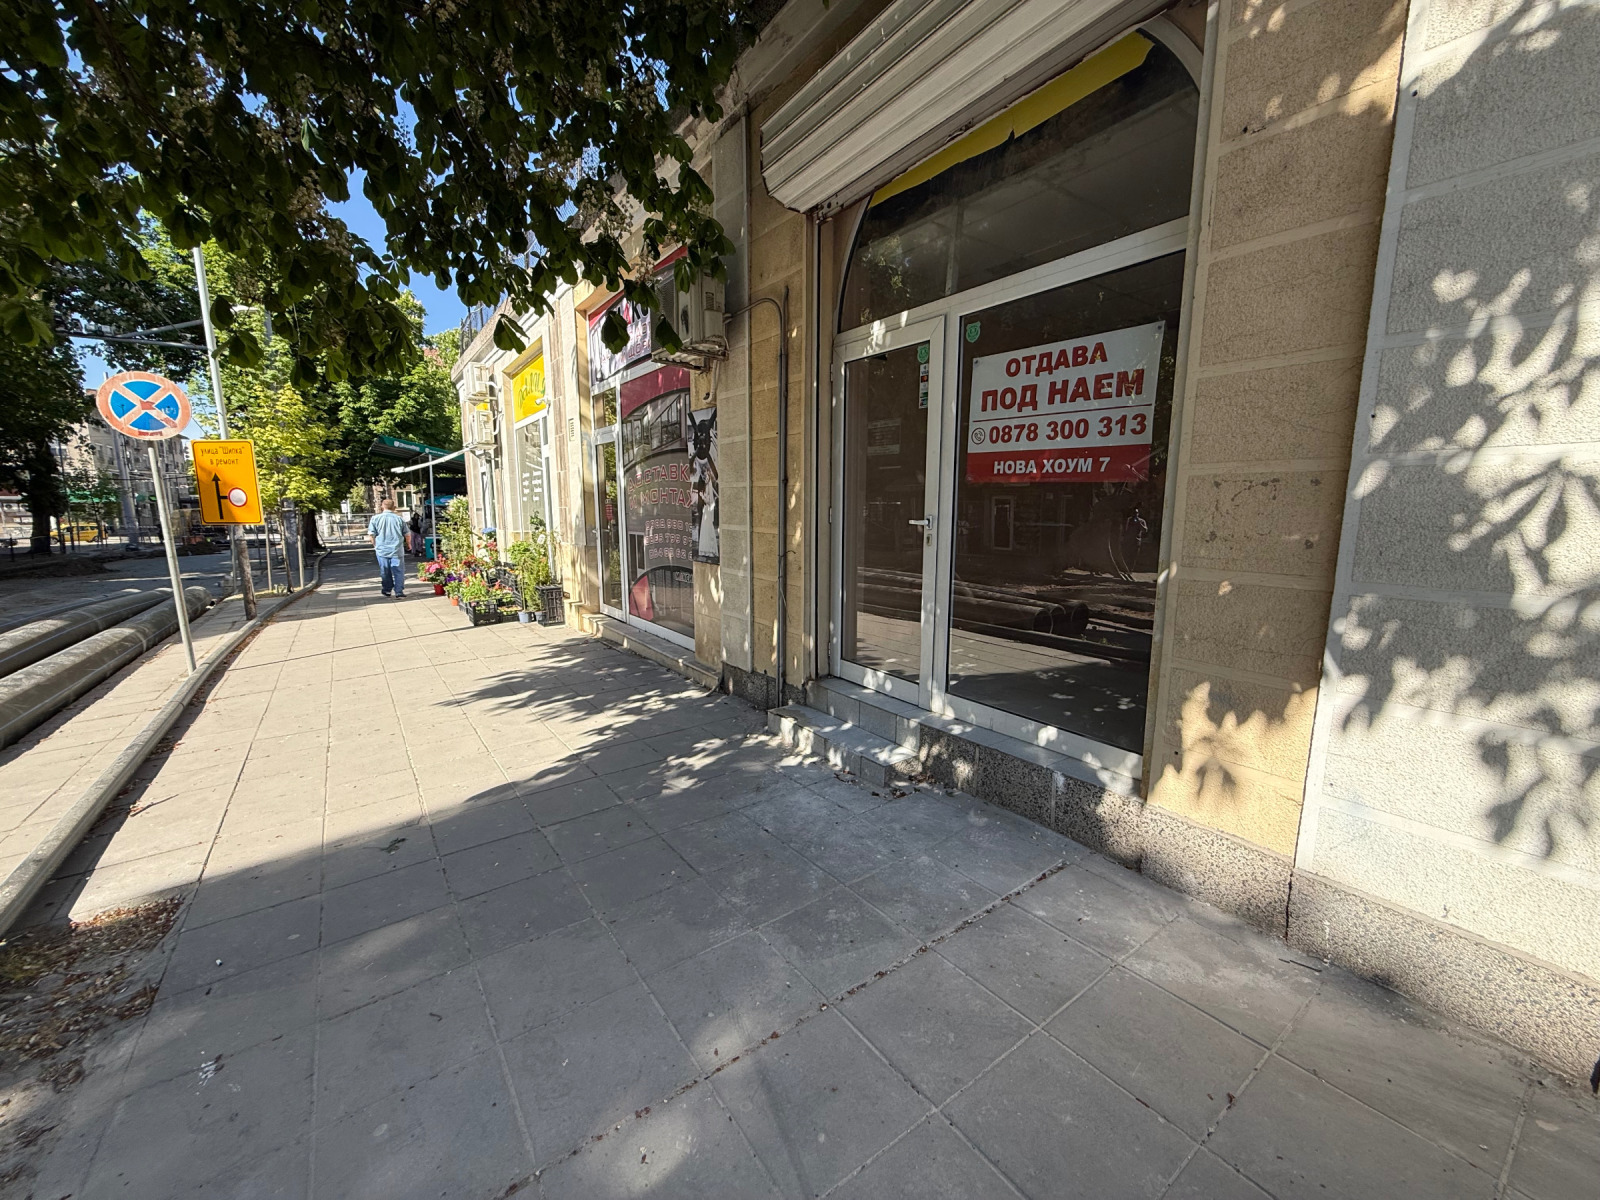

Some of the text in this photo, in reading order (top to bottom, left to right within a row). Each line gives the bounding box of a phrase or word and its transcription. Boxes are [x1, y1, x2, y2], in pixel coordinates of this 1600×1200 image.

[1005, 342, 1108, 378] ОТДАВА
[981, 368, 1145, 413] ПОД НАЕМ
[989, 413, 1147, 444] 0878 300 313
[200, 448, 218, 457] улица
[216, 458, 239, 467] ремонт
[993, 456, 1111, 475] НОВА ХОУМ 7
[627, 463, 691, 495] ДОСТАВК
